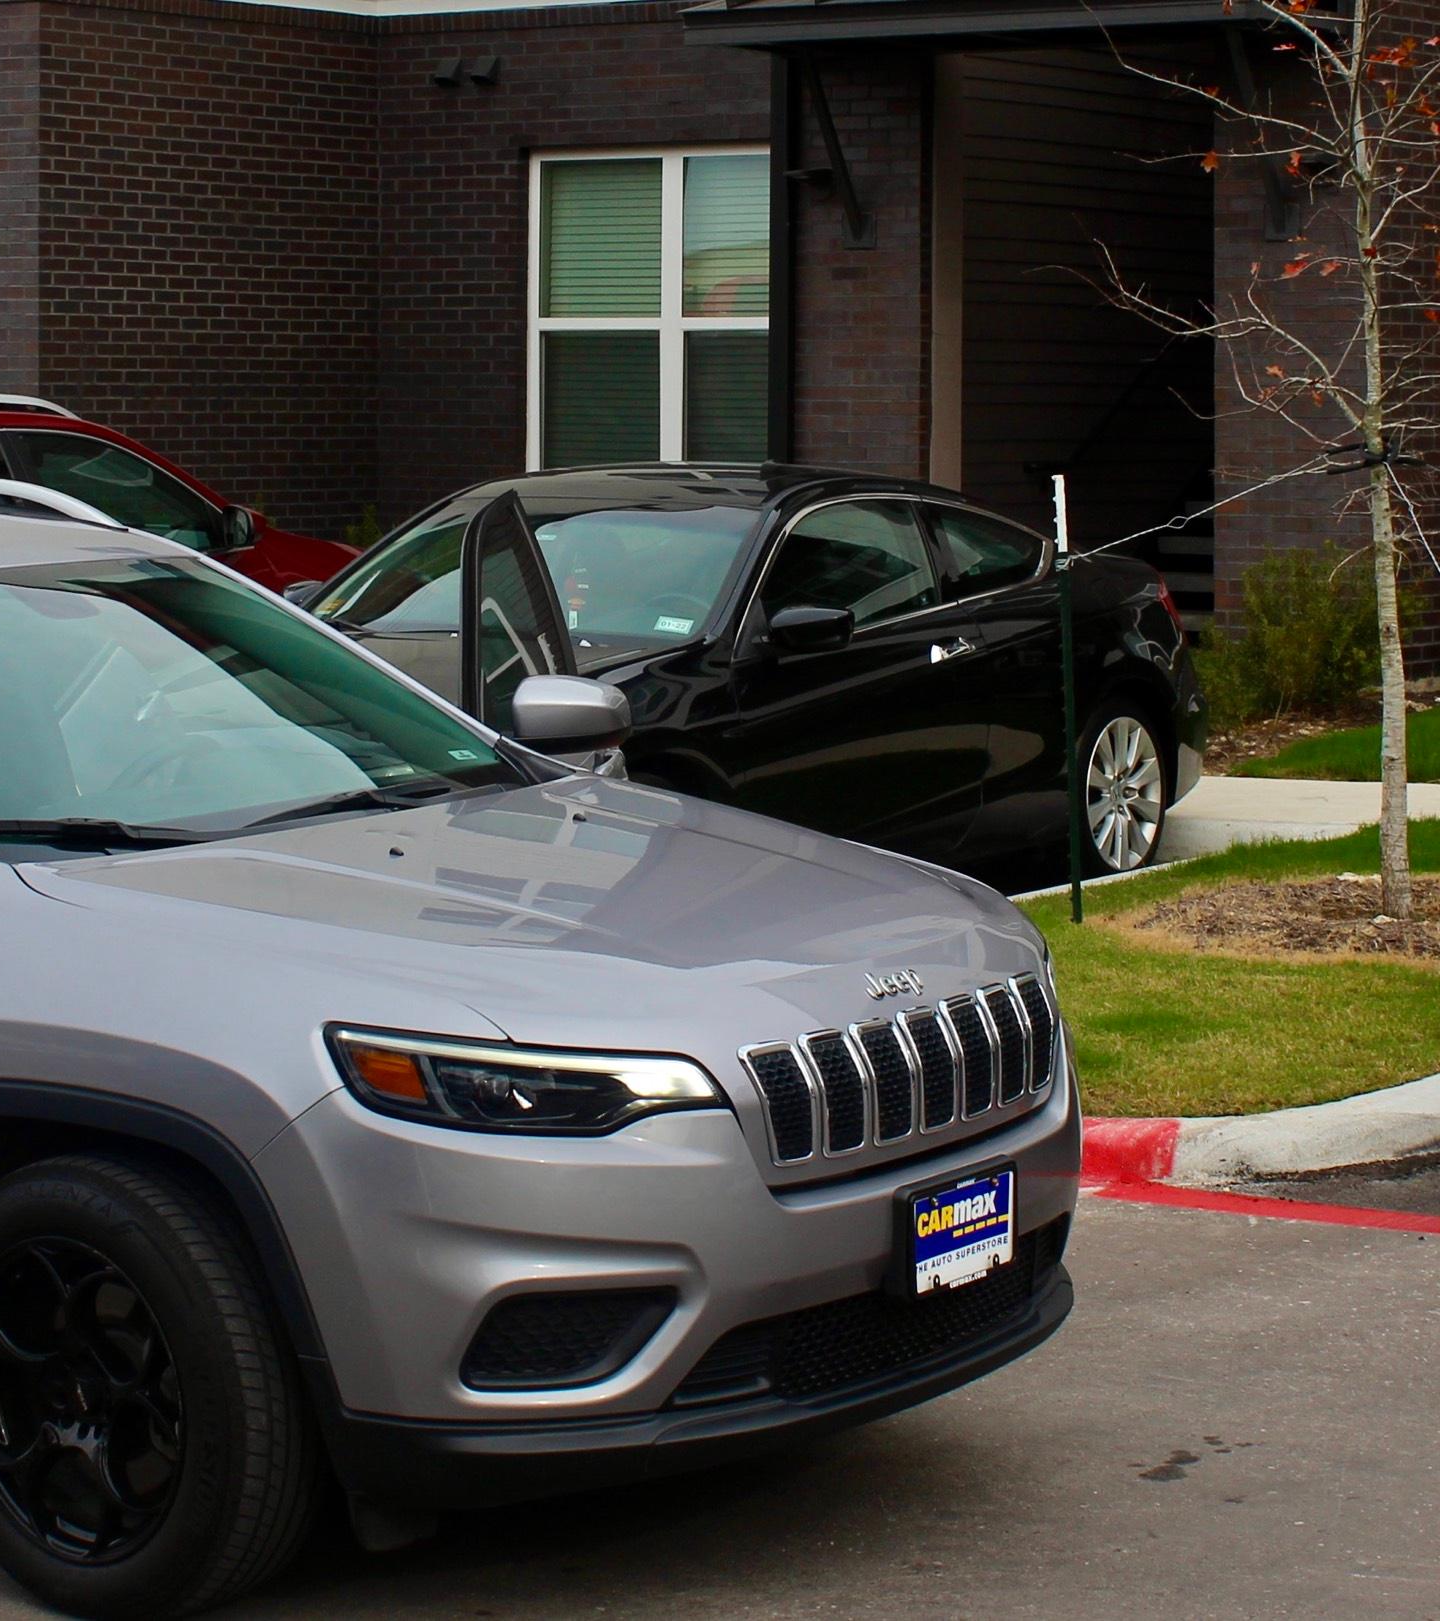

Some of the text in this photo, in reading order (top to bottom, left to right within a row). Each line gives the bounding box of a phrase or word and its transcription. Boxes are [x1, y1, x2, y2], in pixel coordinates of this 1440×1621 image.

[862, 967, 924, 1001] Jeep
[931, 1253, 953, 1269] AUTO
[956, 1235, 1008, 1260] SUPERSTORE
